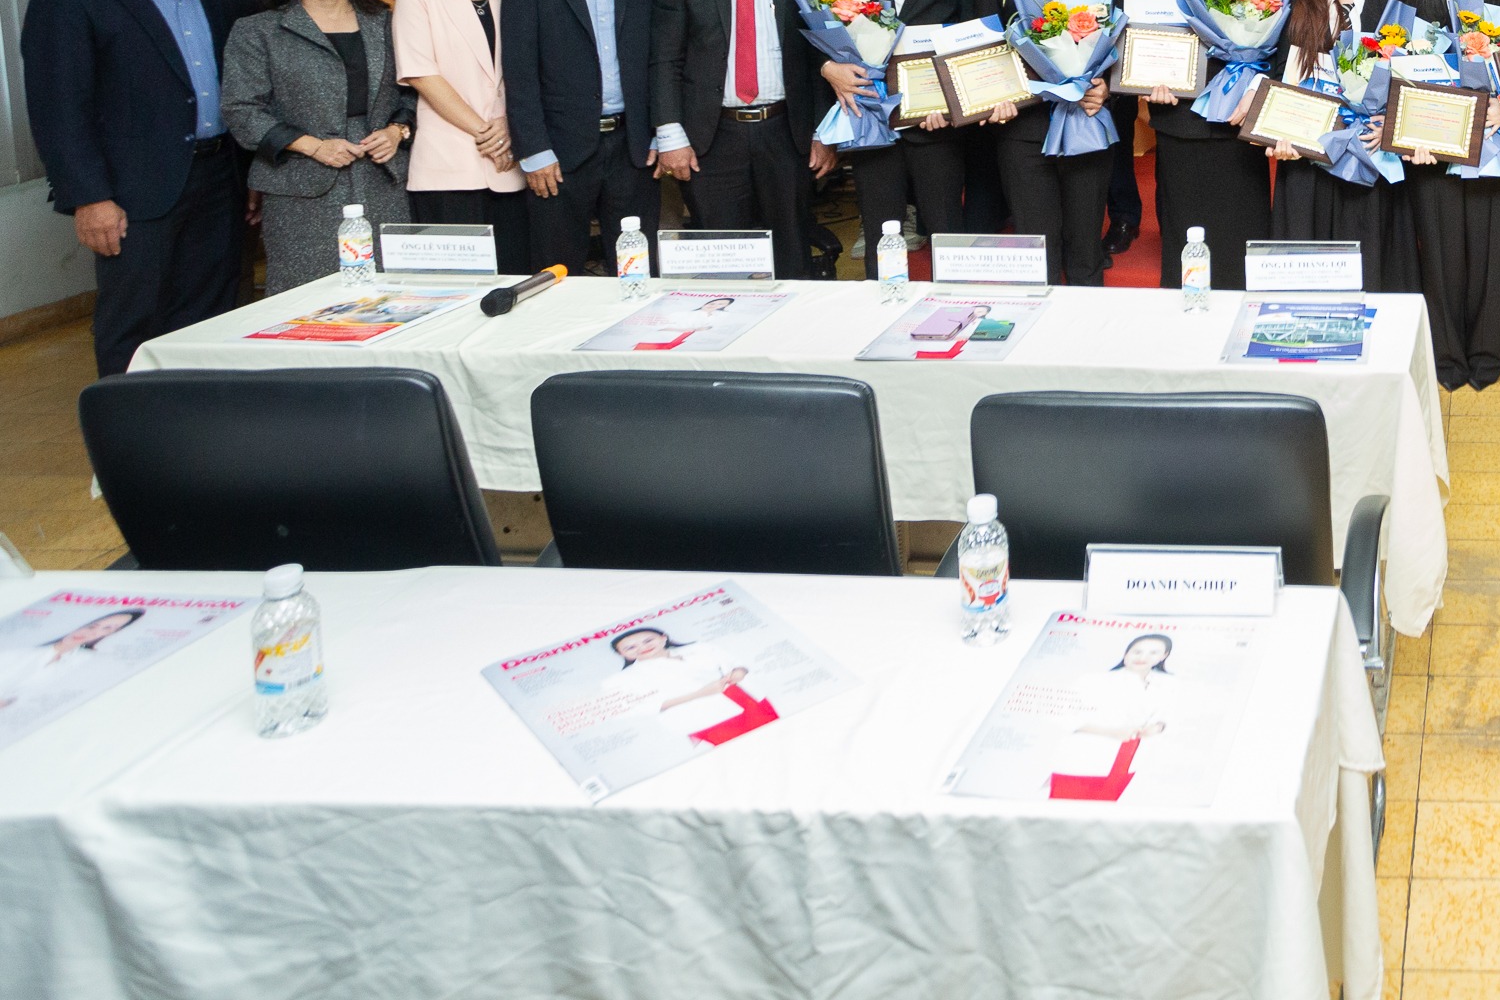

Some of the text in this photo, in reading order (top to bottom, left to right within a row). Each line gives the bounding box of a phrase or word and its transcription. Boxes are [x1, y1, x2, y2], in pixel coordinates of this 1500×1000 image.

[713, 244, 736, 252] MINH
[738, 243, 755, 252] DUY
[1126, 579, 1237, 594] DOANH NGHIỆP
